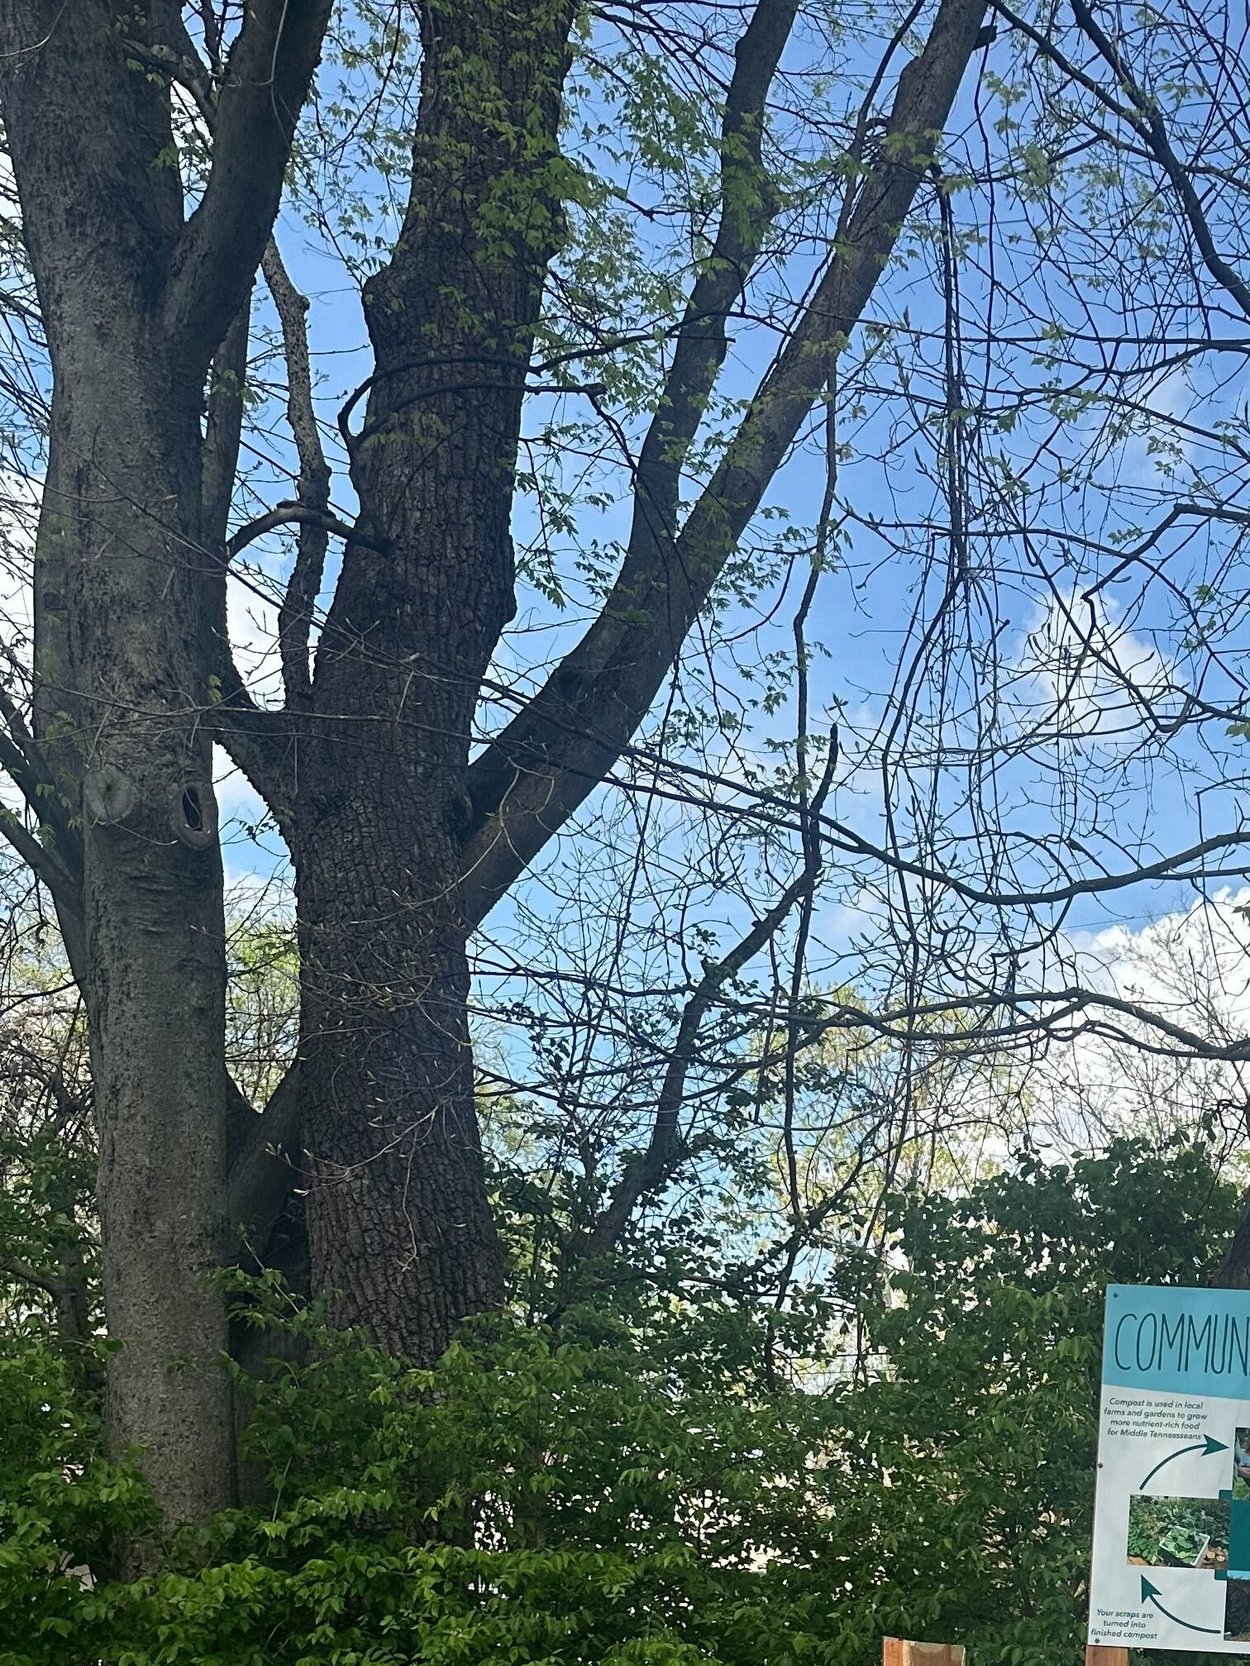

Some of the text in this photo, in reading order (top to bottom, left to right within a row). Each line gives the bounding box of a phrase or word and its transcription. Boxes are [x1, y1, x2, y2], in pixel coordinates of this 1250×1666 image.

[1109, 1397, 1145, 1407] Compost
[1146, 1399, 1153, 1407] is
[1154, 1400, 1174, 1408] used
[1184, 1401, 1203, 1410] local
[1104, 1408, 1125, 1416] farms
[1127, 1409, 1143, 1417] and
[1144, 1410, 1176, 1419] gardens
[1187, 1413, 1208, 1421] grow
[1132, 1420, 1180, 1429] nutrient-rich
[1181, 1422, 1200, 1430] food
[1107, 1428, 1119, 1436] for
[1120, 1429, 1148, 1438] Middle
[1097, 1608, 1114, 1617] Your
[1115, 1611, 1140, 1619] scraps
[1103, 1620, 1146, 1629] turned into
[1090, 1628, 1158, 1640] finished compost
